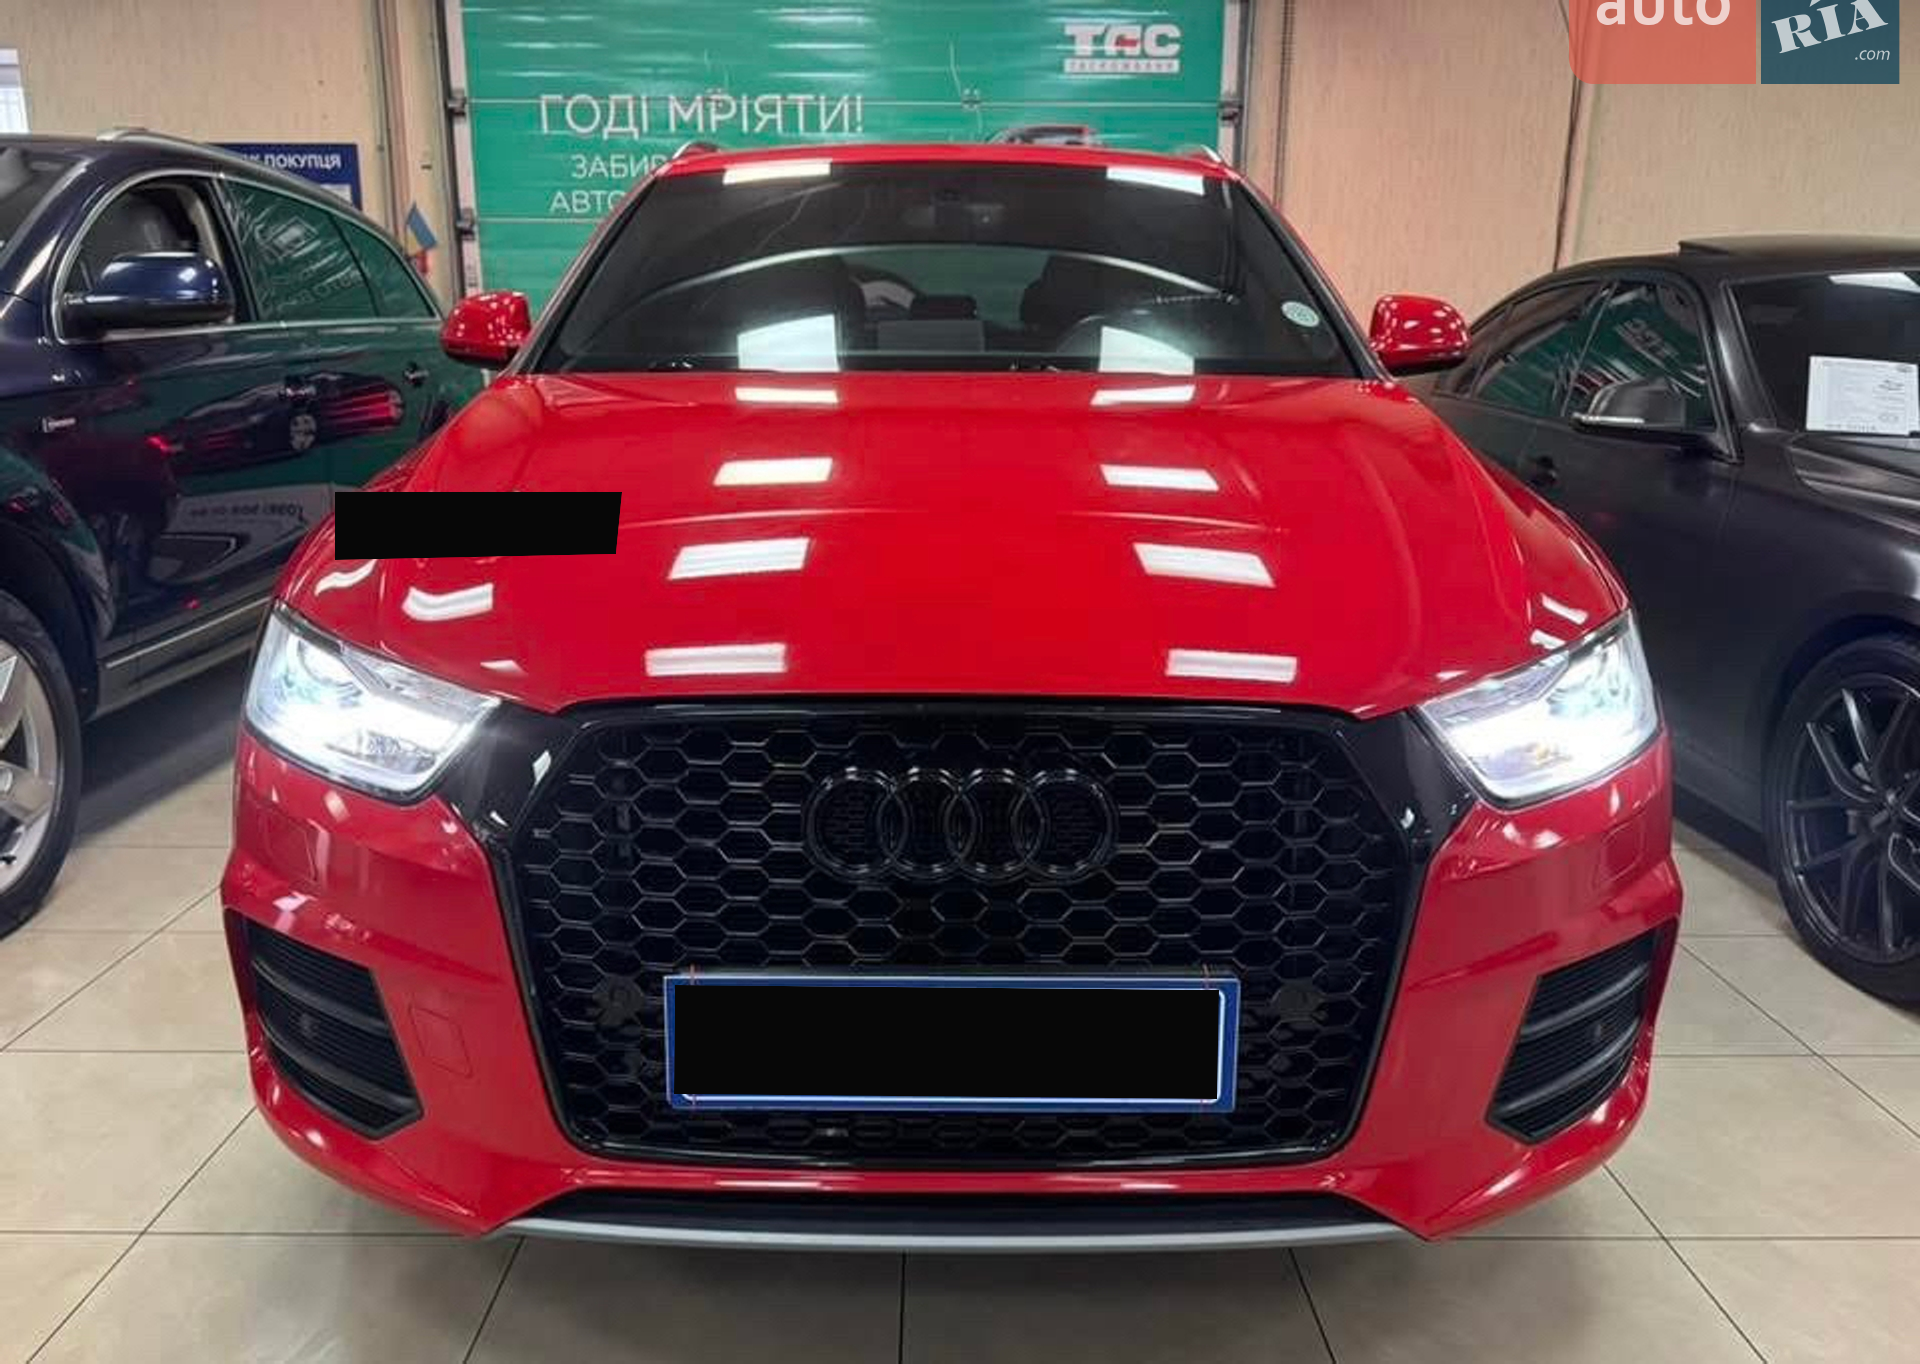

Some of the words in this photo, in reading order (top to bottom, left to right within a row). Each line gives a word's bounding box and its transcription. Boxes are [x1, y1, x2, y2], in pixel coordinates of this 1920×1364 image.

[539, 94, 648, 140] ГОДІ
[668, 93, 865, 134] МРІЯТИ!
[263, 153, 342, 171] ПОКУПЦЯ
